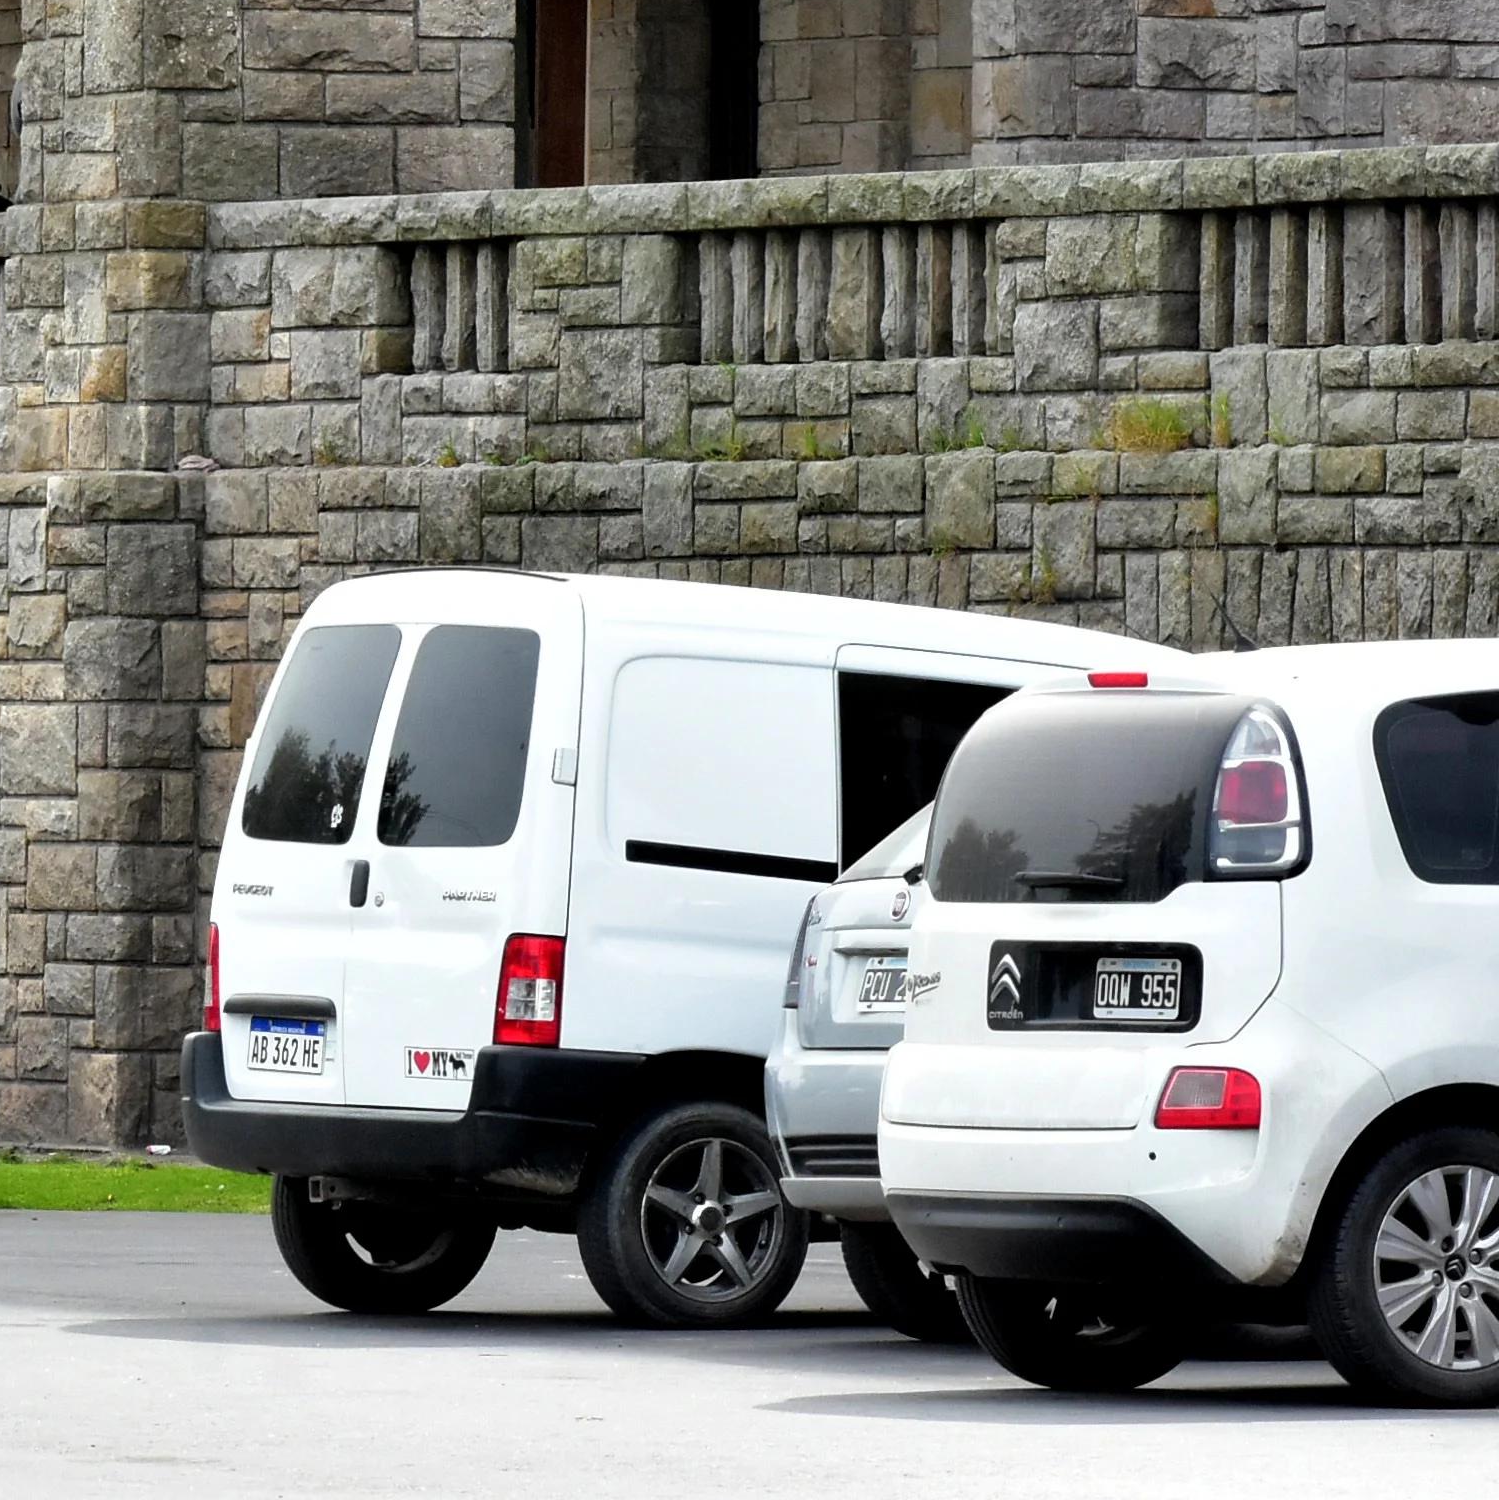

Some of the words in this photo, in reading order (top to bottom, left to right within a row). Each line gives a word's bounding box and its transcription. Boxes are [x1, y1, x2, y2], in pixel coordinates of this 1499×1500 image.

[232, 883, 274, 897] PEUGEOT
[442, 889, 498, 902] PARTNER
[860, 971, 892, 1001] PCU
[1097, 973, 1131, 1007] OQW
[1141, 974, 1177, 1008] 955
[251, 1035, 269, 1064] AB
[272, 1036, 299, 1067] 362
[302, 1039, 320, 1068] HE
[431, 1051, 449, 1077] MY
